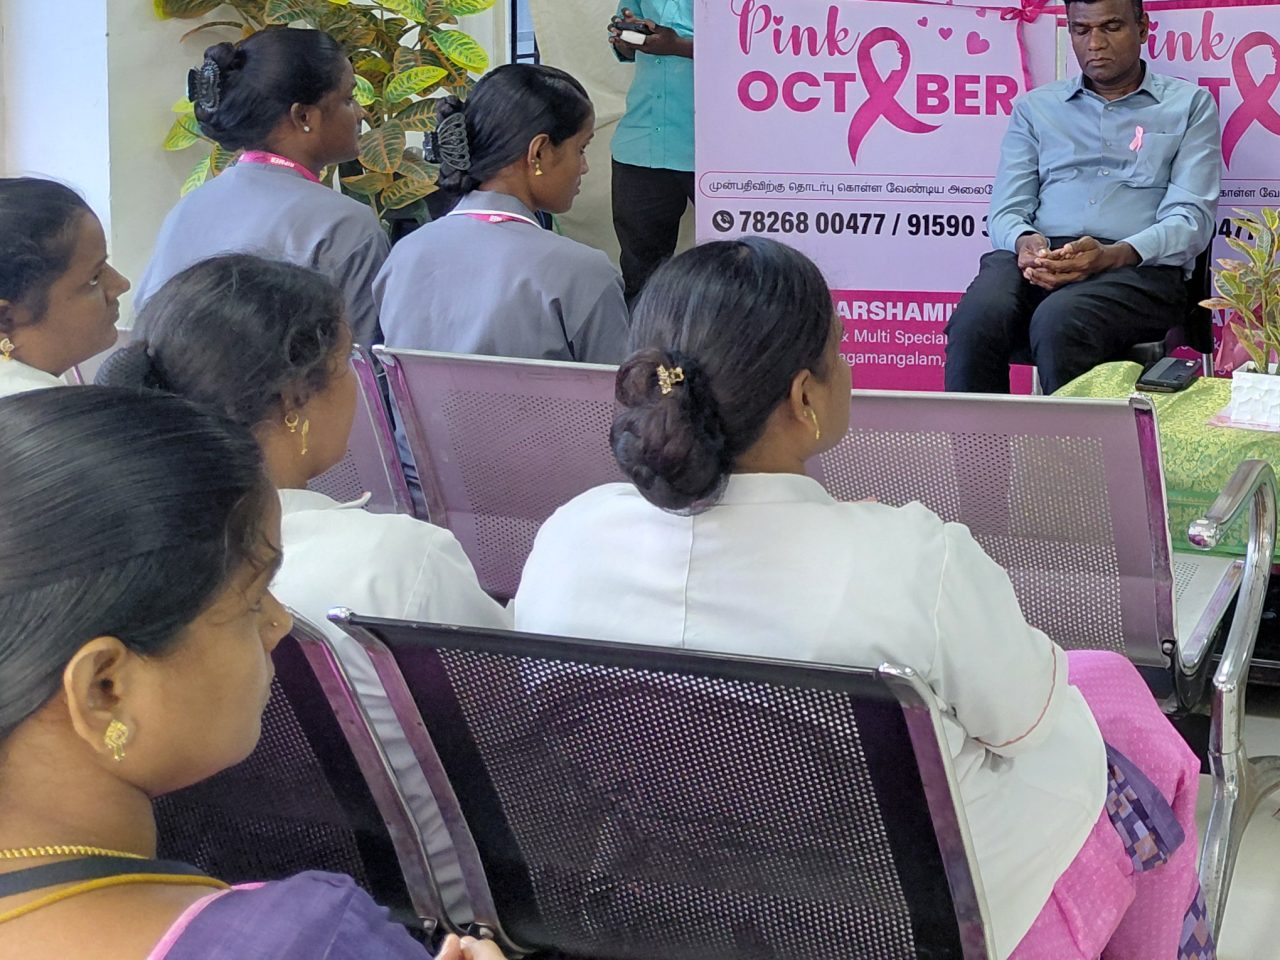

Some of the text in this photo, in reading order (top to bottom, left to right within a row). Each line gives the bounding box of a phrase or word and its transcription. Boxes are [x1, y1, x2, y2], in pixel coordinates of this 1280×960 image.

[709, 180, 945, 196] முன்பதிவிற்கு தொடர்பு கொள்ள வேண்டிய
[739, 211, 809, 233] 78268
[816, 212, 886, 235] 00477
[908, 214, 975, 237] 91590
[854, 330, 890, 343] Multi
